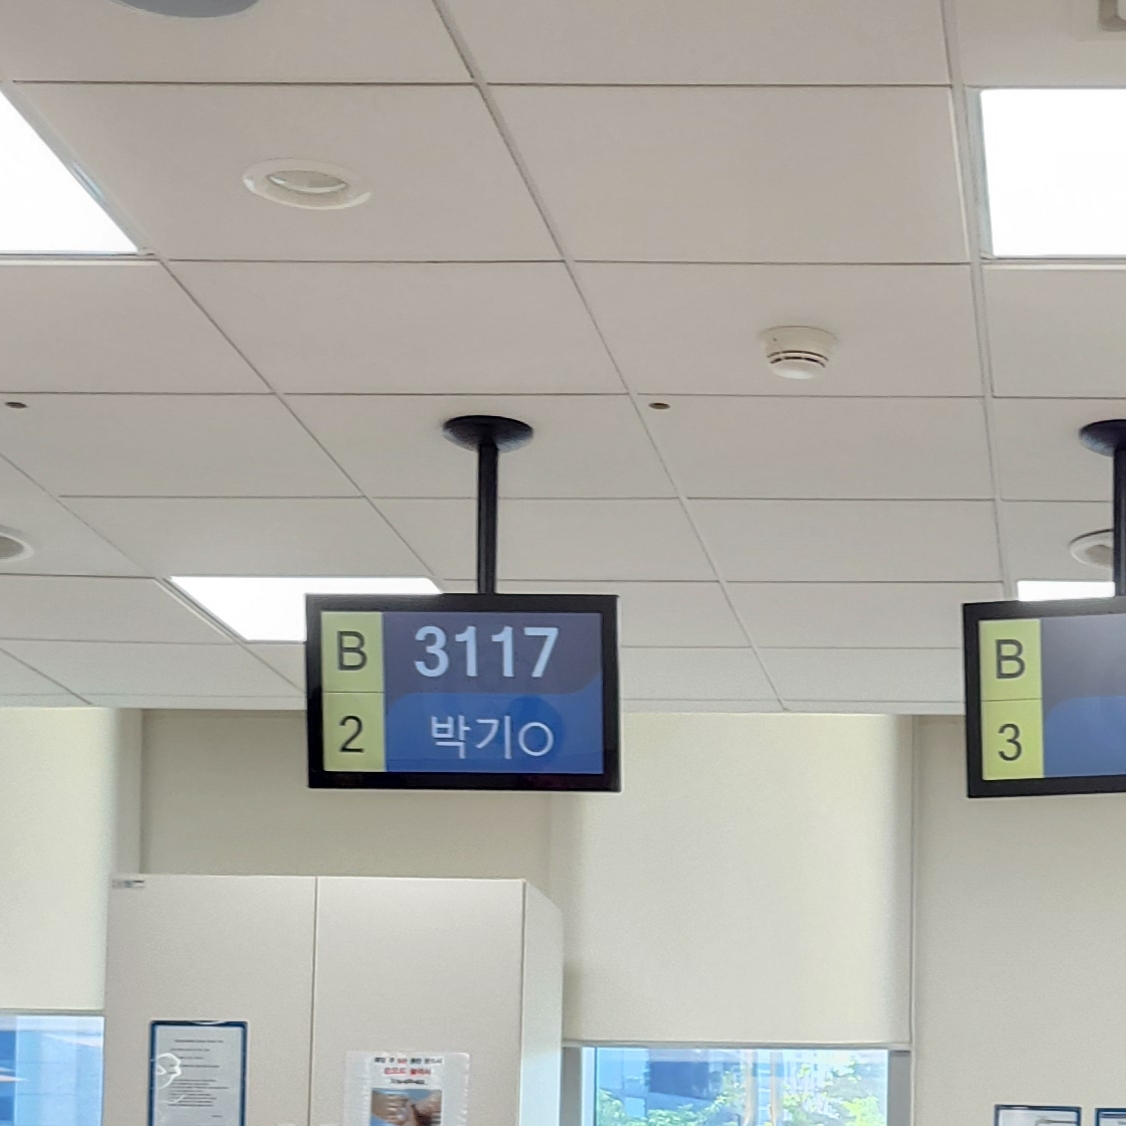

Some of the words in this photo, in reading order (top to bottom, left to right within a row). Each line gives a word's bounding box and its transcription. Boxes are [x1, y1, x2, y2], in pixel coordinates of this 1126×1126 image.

[336, 630, 367, 671] B
[414, 625, 559, 677] 3117
[995, 639, 1026, 680] B
[338, 715, 365, 753] 2
[997, 723, 1022, 761] 3
